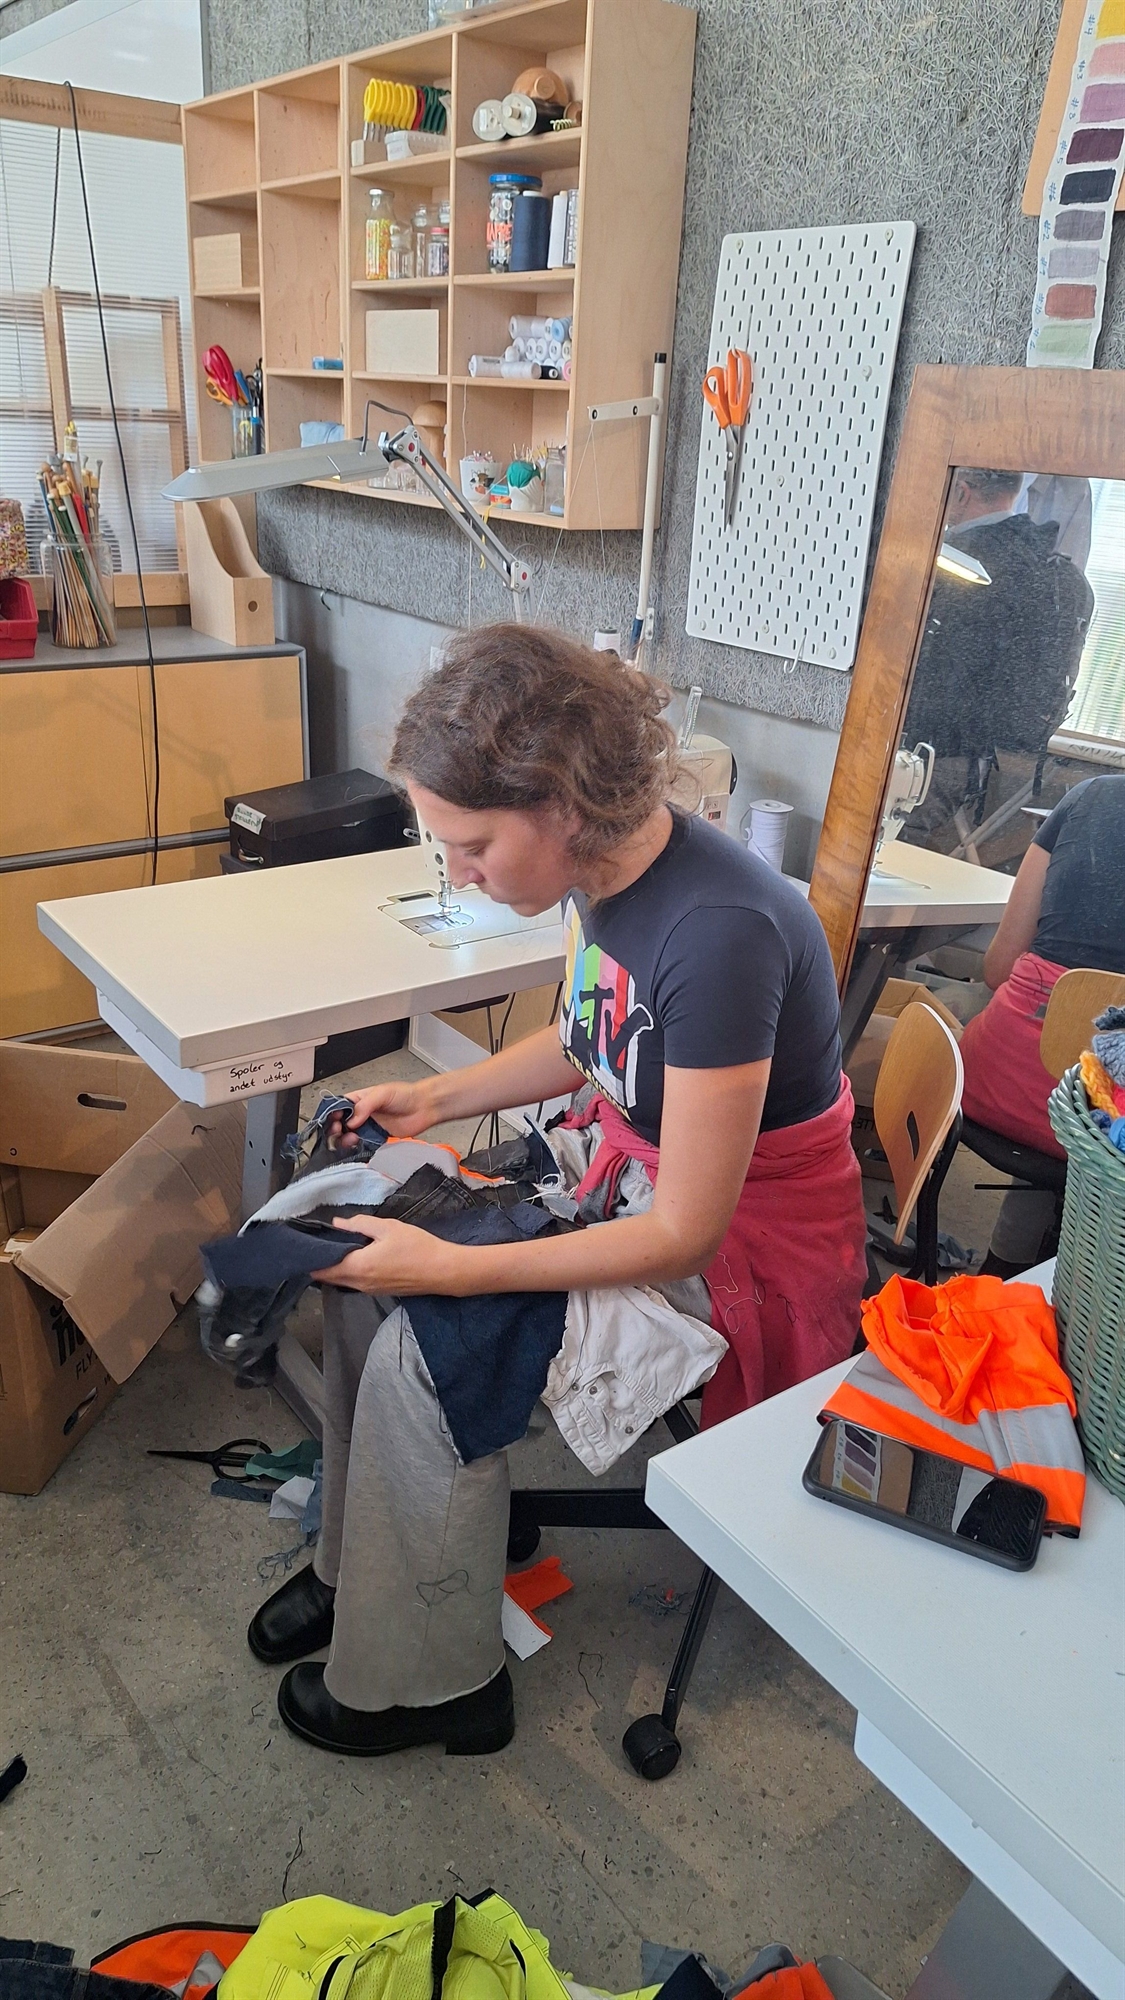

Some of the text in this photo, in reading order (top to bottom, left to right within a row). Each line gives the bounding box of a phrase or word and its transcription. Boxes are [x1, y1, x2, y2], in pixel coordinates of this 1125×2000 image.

[229, 1063, 265, 1079] Spoler
[229, 1079, 256, 1093] andet
[75, 1348, 98, 1381] FLY
